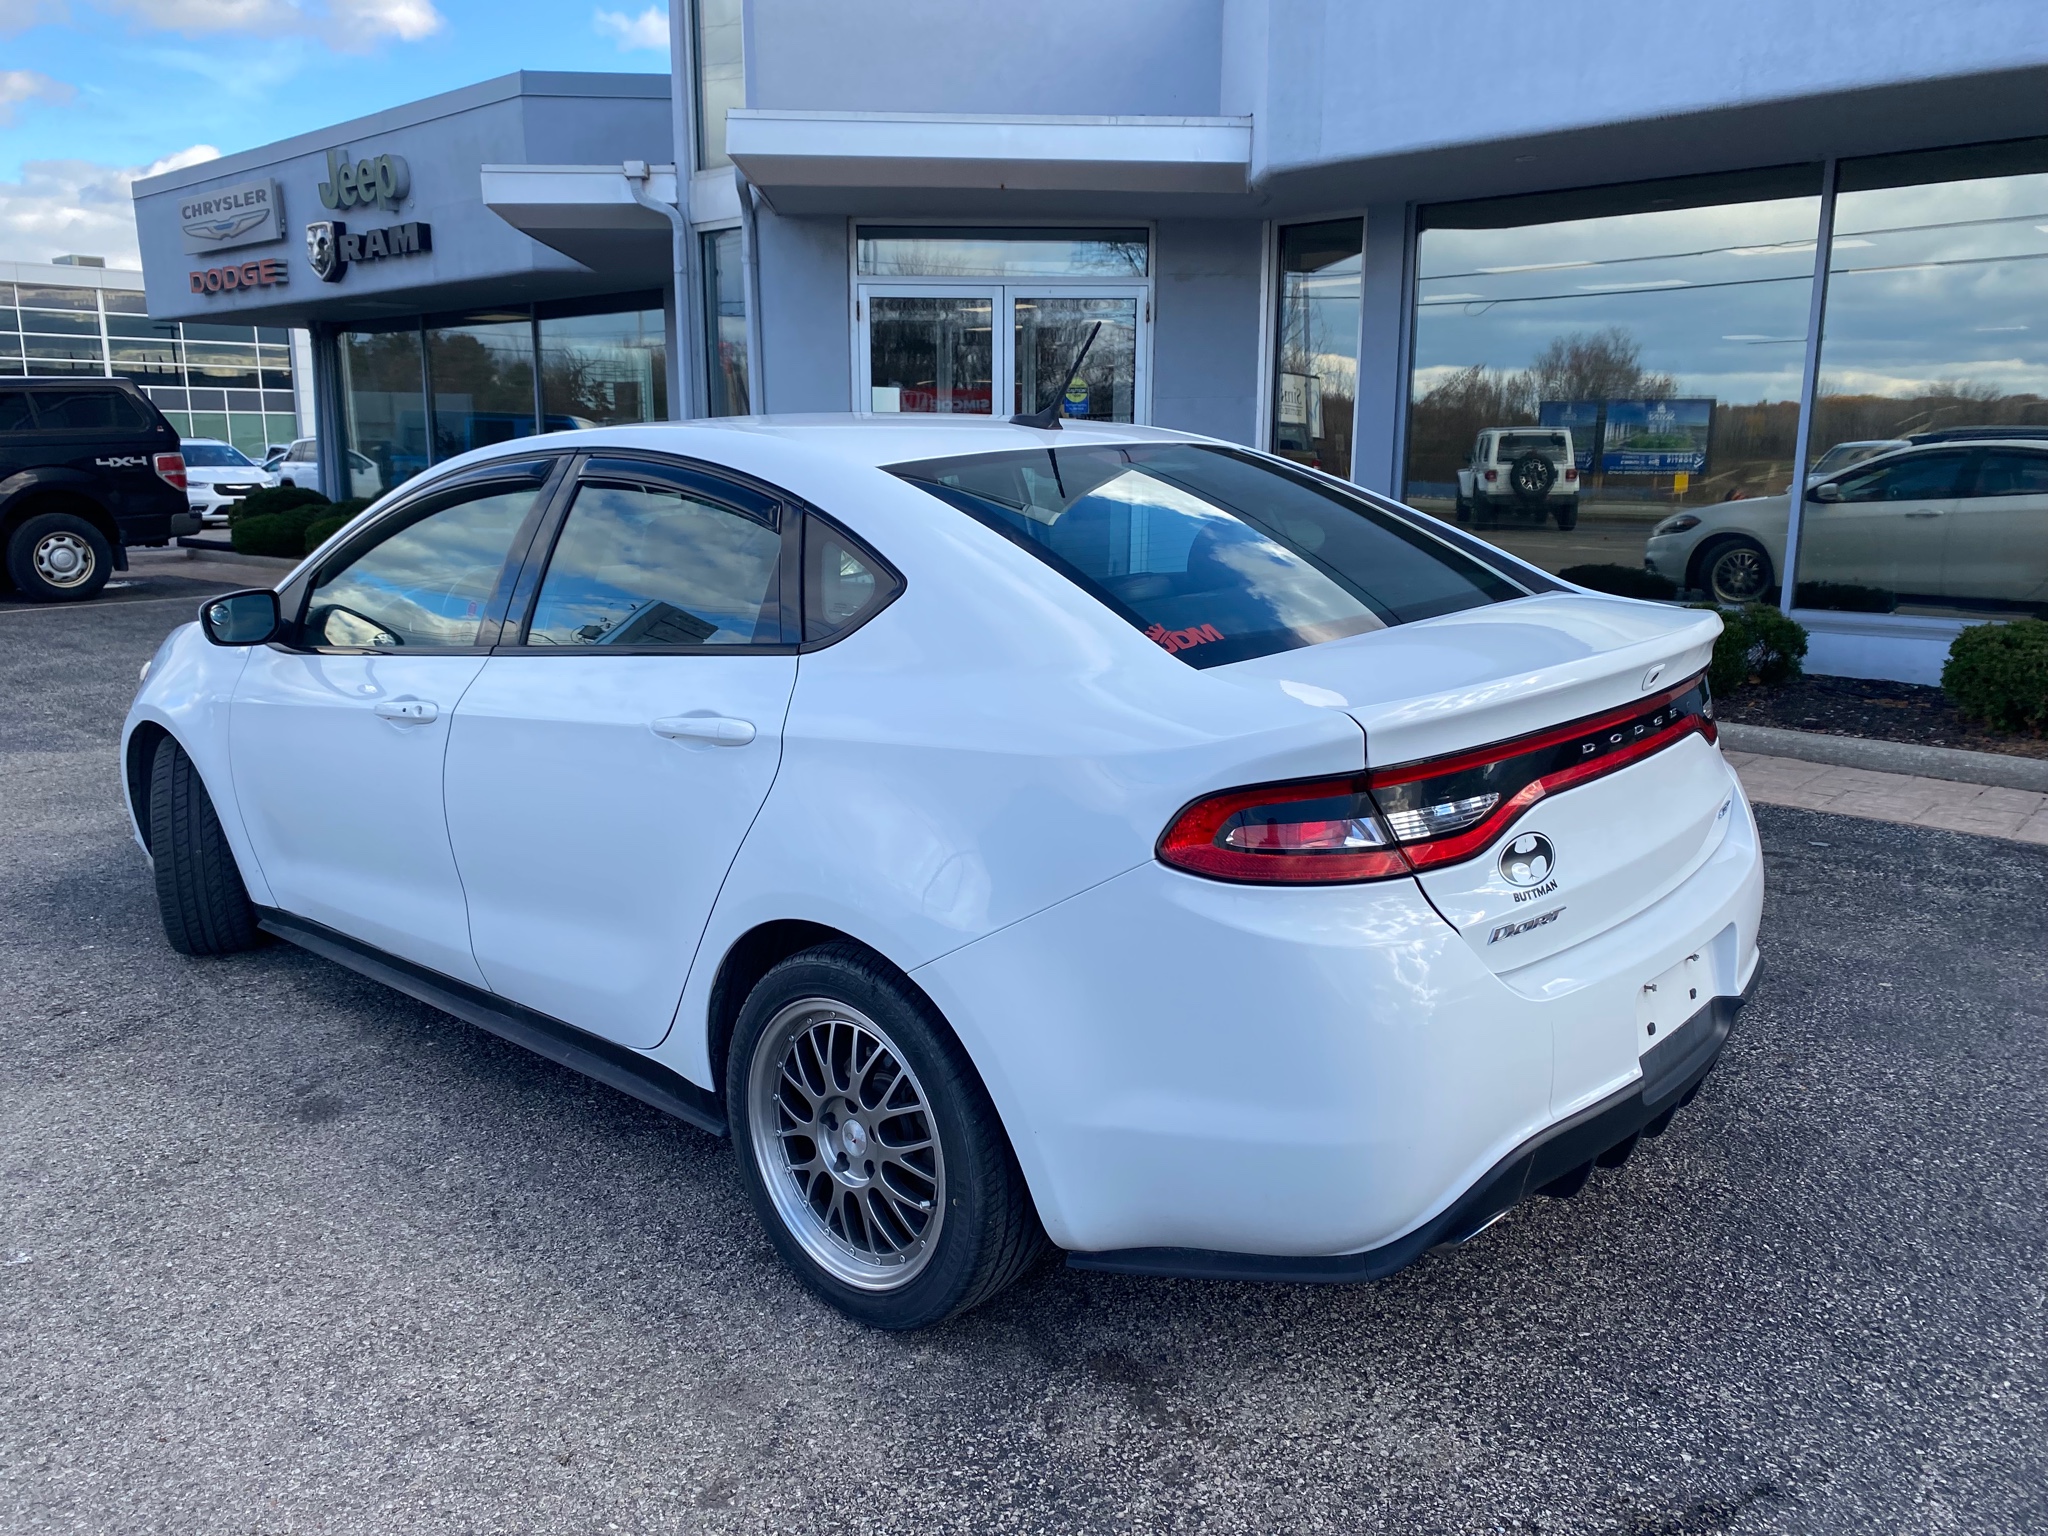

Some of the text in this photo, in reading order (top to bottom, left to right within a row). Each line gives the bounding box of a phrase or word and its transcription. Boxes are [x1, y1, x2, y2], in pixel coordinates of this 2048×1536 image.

[318, 150, 402, 212] Jeep
[182, 188, 268, 220] CHRYSLER
[339, 222, 421, 263] RAM
[189, 258, 277, 293] DODGE
[1163, 624, 1223, 654] JDM
[1582, 707, 1678, 754] DODGE
[1513, 879, 1558, 903] BUTTMAN
